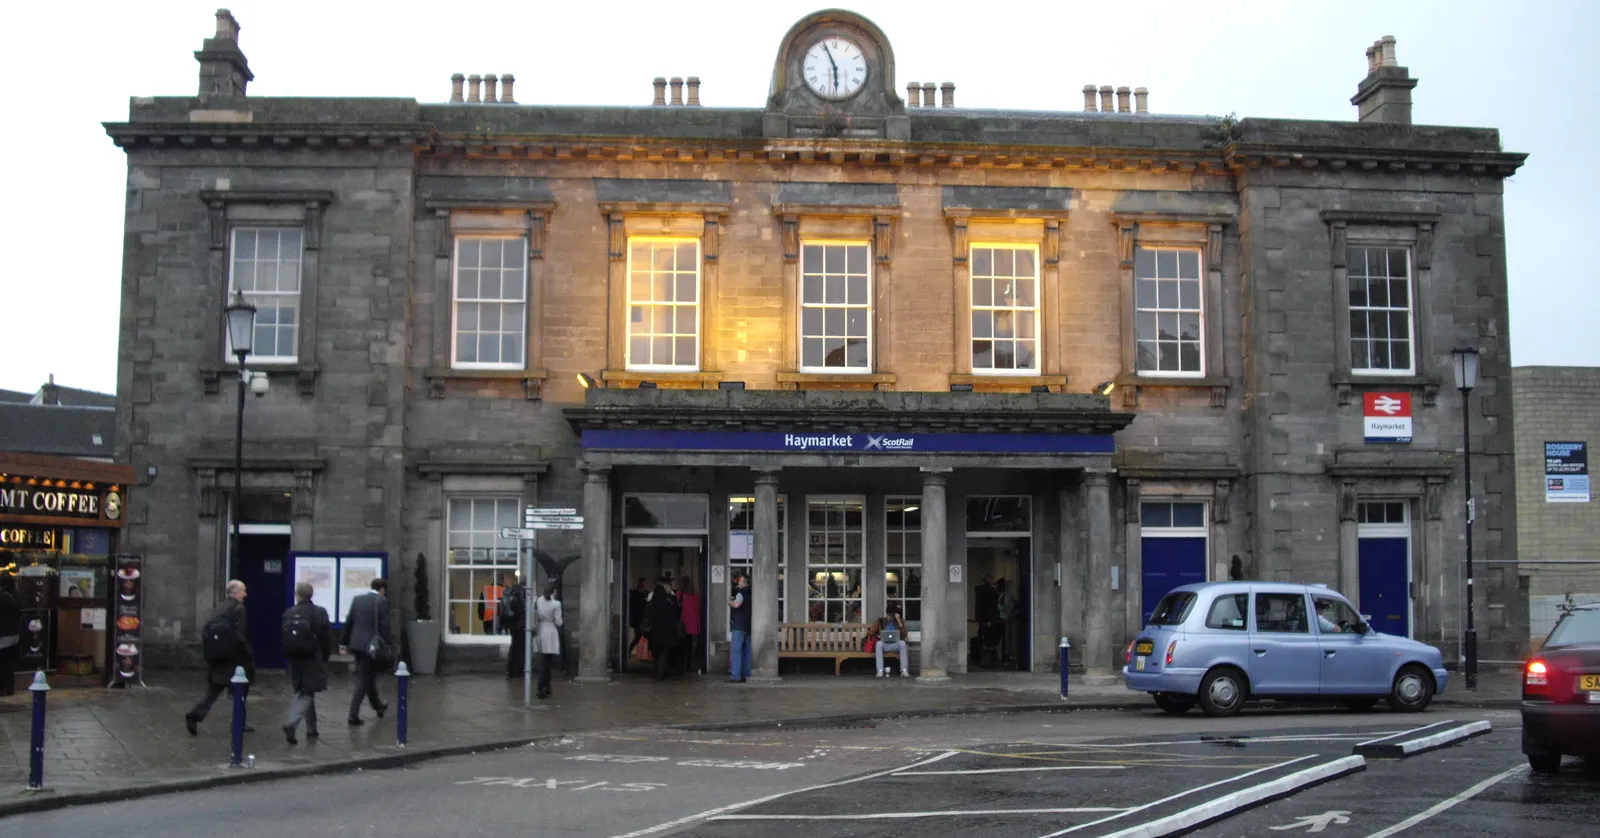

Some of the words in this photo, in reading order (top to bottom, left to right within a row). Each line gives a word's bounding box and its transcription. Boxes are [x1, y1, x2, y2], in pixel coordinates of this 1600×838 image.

[1371, 422, 1406, 431] Haymarket
[785, 434, 853, 449] Haymarket
[882, 437, 914, 446] ScotRail
[0, 488, 29, 508] MT
[32, 491, 99, 514] COFFEE
[0, 528, 51, 545] COFFEE
[453, 776, 669, 792] TAXIS
